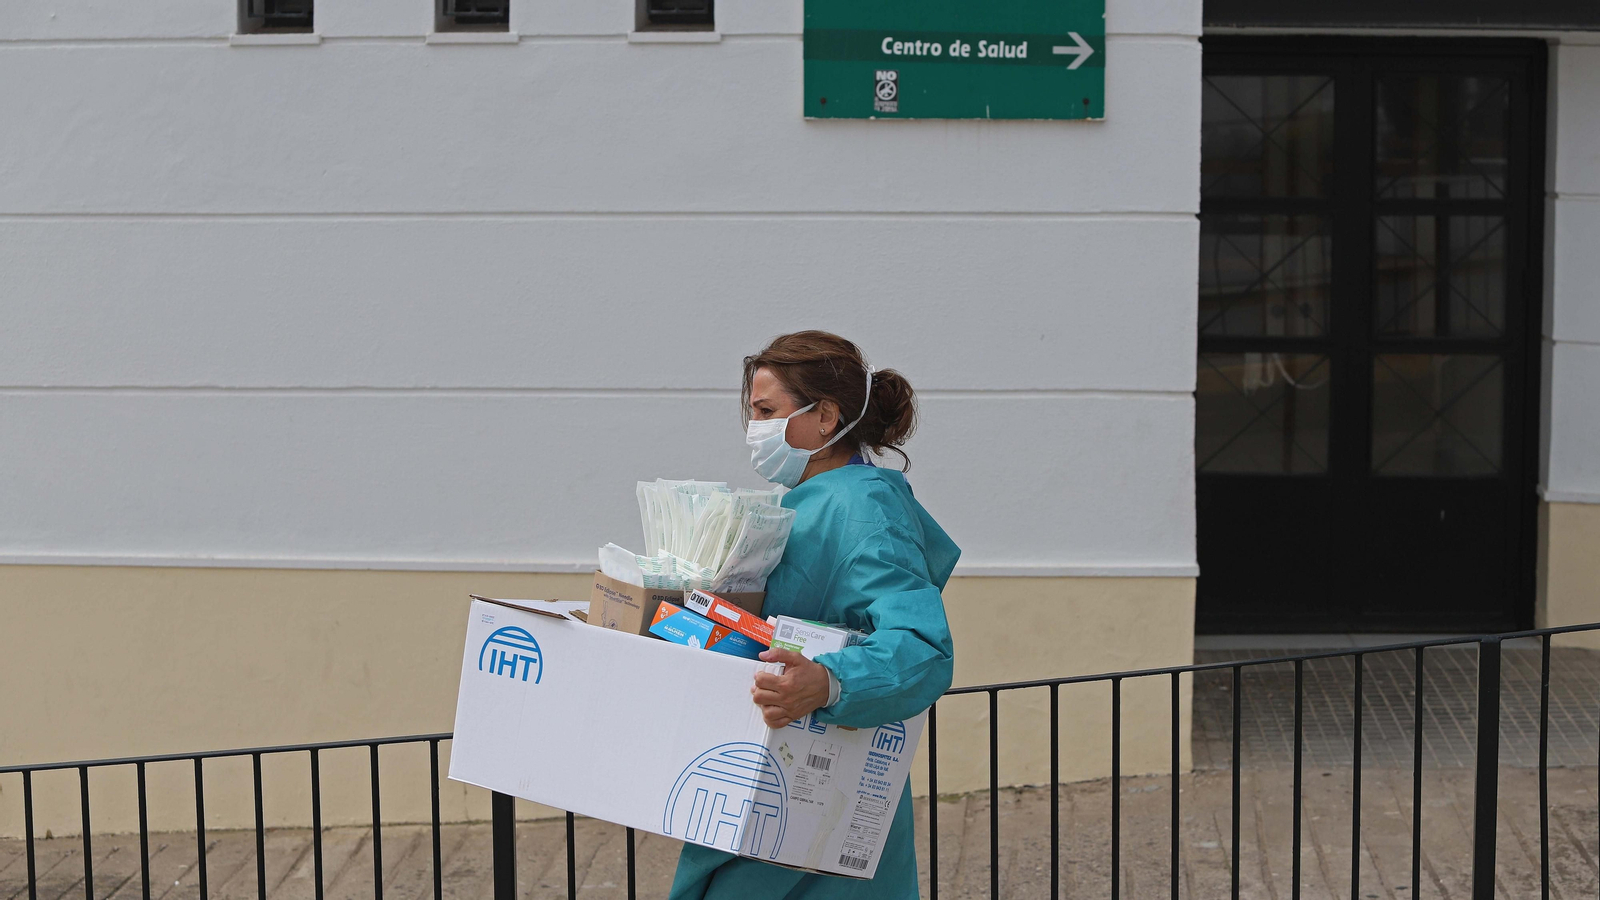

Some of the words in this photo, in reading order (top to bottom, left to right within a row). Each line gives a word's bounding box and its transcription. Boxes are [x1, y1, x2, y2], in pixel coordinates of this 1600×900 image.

[882, 37, 942, 56] Centro
[949, 40, 971, 57] de
[978, 40, 1028, 58] Salud
[876, 71, 897, 81] NO
[690, 593, 710, 608] NULO
[793, 634, 807, 644] Free
[489, 648, 537, 682] IHT
[877, 732, 902, 752] IHT
[685, 788, 779, 856] IHT
